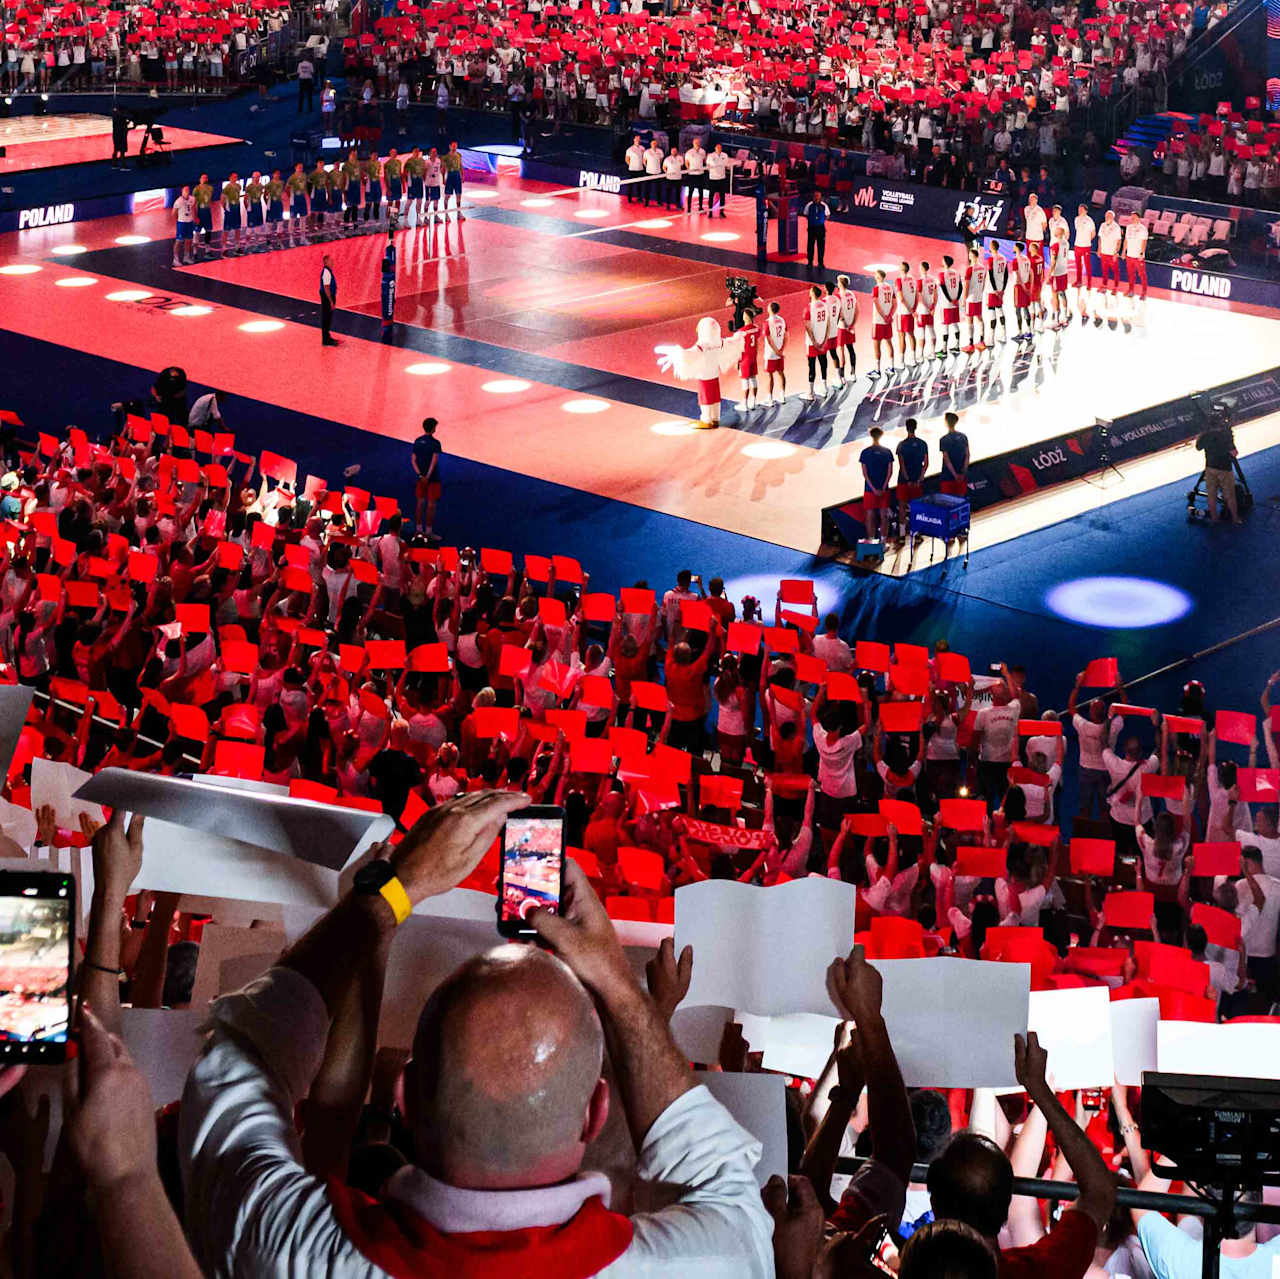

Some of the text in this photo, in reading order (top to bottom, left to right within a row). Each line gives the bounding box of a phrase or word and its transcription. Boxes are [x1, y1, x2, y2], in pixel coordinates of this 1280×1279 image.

[579, 170, 621, 193] POLAND
[854, 186, 877, 208] VNL
[18, 203, 74, 230] POLAND
[1171, 270, 1231, 299] POLAND
[1032, 446, 1067, 470] ŁÓDŹ
